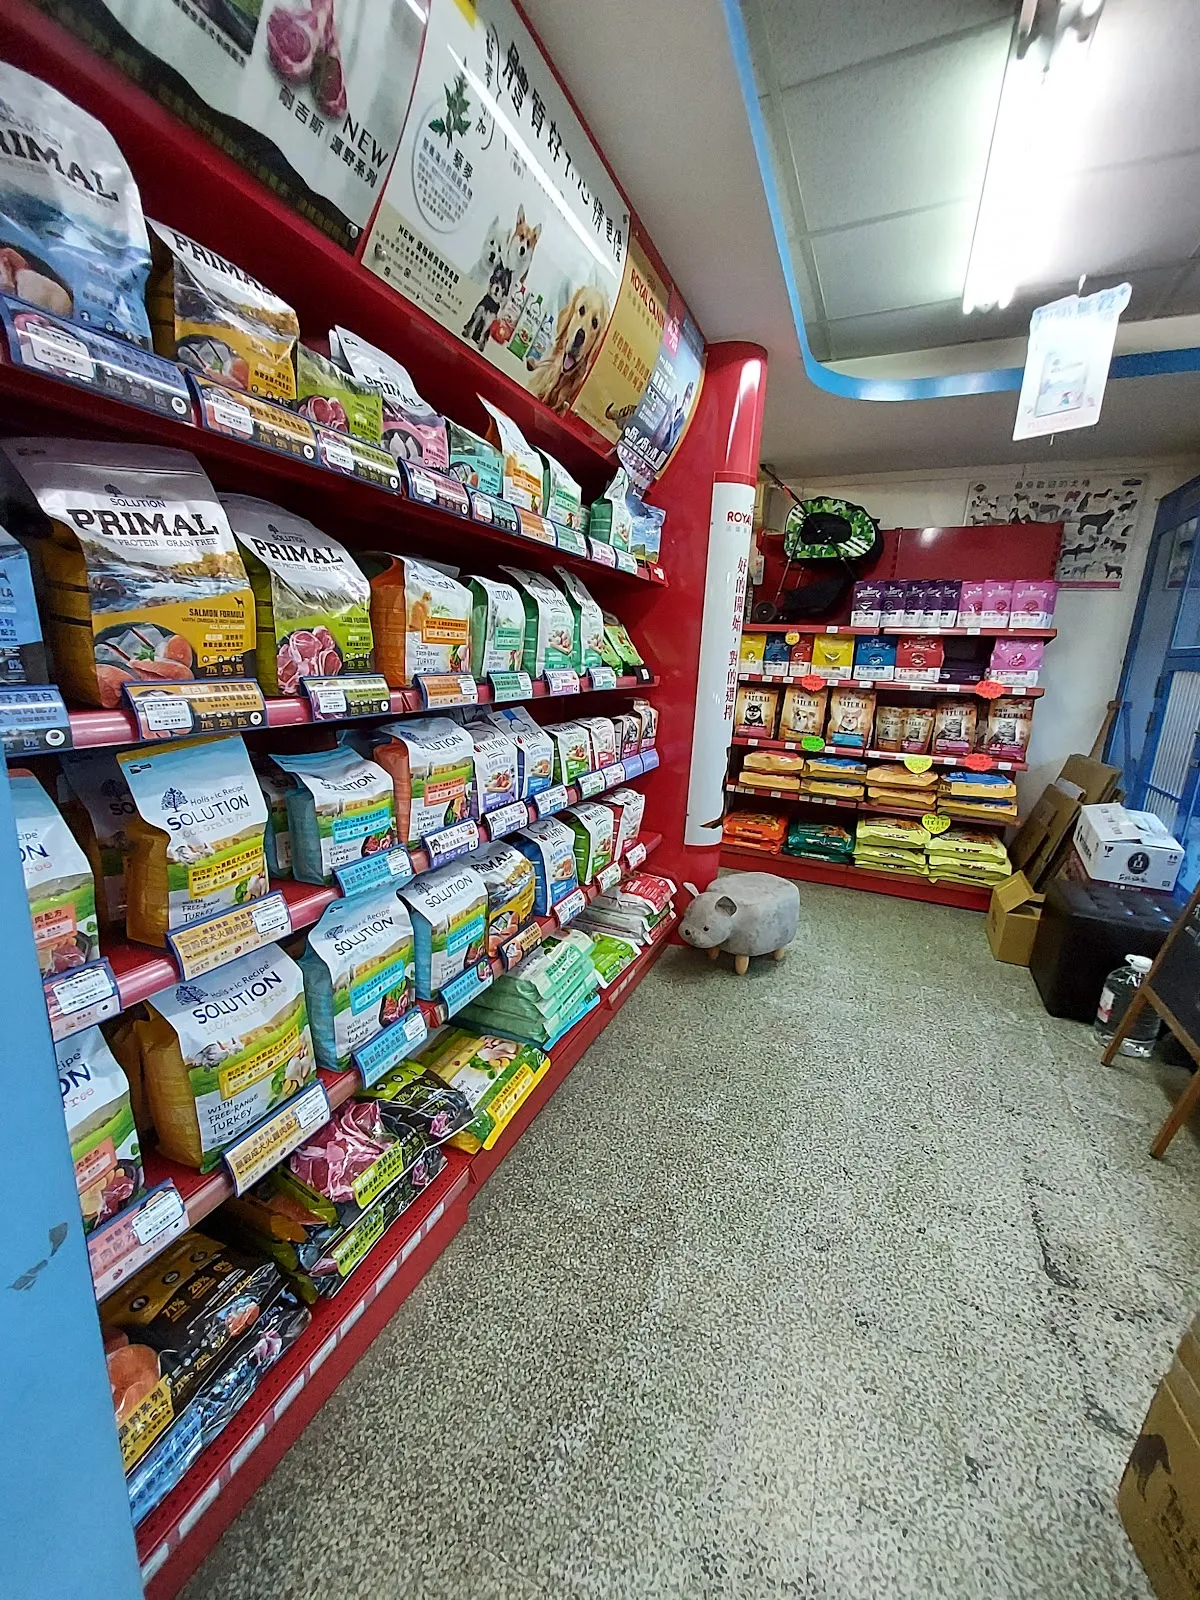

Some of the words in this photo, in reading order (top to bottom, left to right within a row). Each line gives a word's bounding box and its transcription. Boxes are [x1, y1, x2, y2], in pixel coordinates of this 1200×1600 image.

[278, 84, 324, 138] 耐吉斯
[343, 113, 389, 168] NEW
[331, 132, 378, 188] 源野系列
[398, 224, 415, 243] NEW
[631, 268, 648, 308] ROYAL
[110, 497, 166, 509] SOLUTION
[66, 509, 220, 537] PRIMAL
[117, 538, 159, 548] PROTEIN
[166, 539, 195, 548] GRAIN
[195, 538, 219, 547] FREE
[271, 534, 307, 544] SOLUTION
[250, 537, 344, 564] PRIMAL
[189, 608, 218, 618] SALMON
[219, 608, 245, 619] FORMULA
[744, 694, 770, 702] NATURAL
[792, 698, 819, 707] NATURAL
[838, 700, 867, 709] NATURAL
[222, 784, 244, 800] Recipe
[166, 793, 250, 831] SOLUTION
[418, 820, 435, 830] LAMB
[330, 855, 350, 865] LAMB
[472, 850, 513, 875] PRIMAL
[425, 875, 473, 908] SOLUTION
[34, 909, 62, 924] 肉配方
[183, 907, 214, 923] TURKEY
[334, 916, 394, 956] SOLUTION
[242, 962, 271, 983] Recipe
[192, 970, 282, 1025] SOLUTION
[207, 1100, 233, 1114] WITH
[208, 1093, 259, 1125] FREE-RANGE
[210, 1106, 252, 1134] TURKEY
[161, 1297, 185, 1318] 71%
[187, 1275, 211, 1294] 29%
[213, 1260, 230, 1273] 0%
